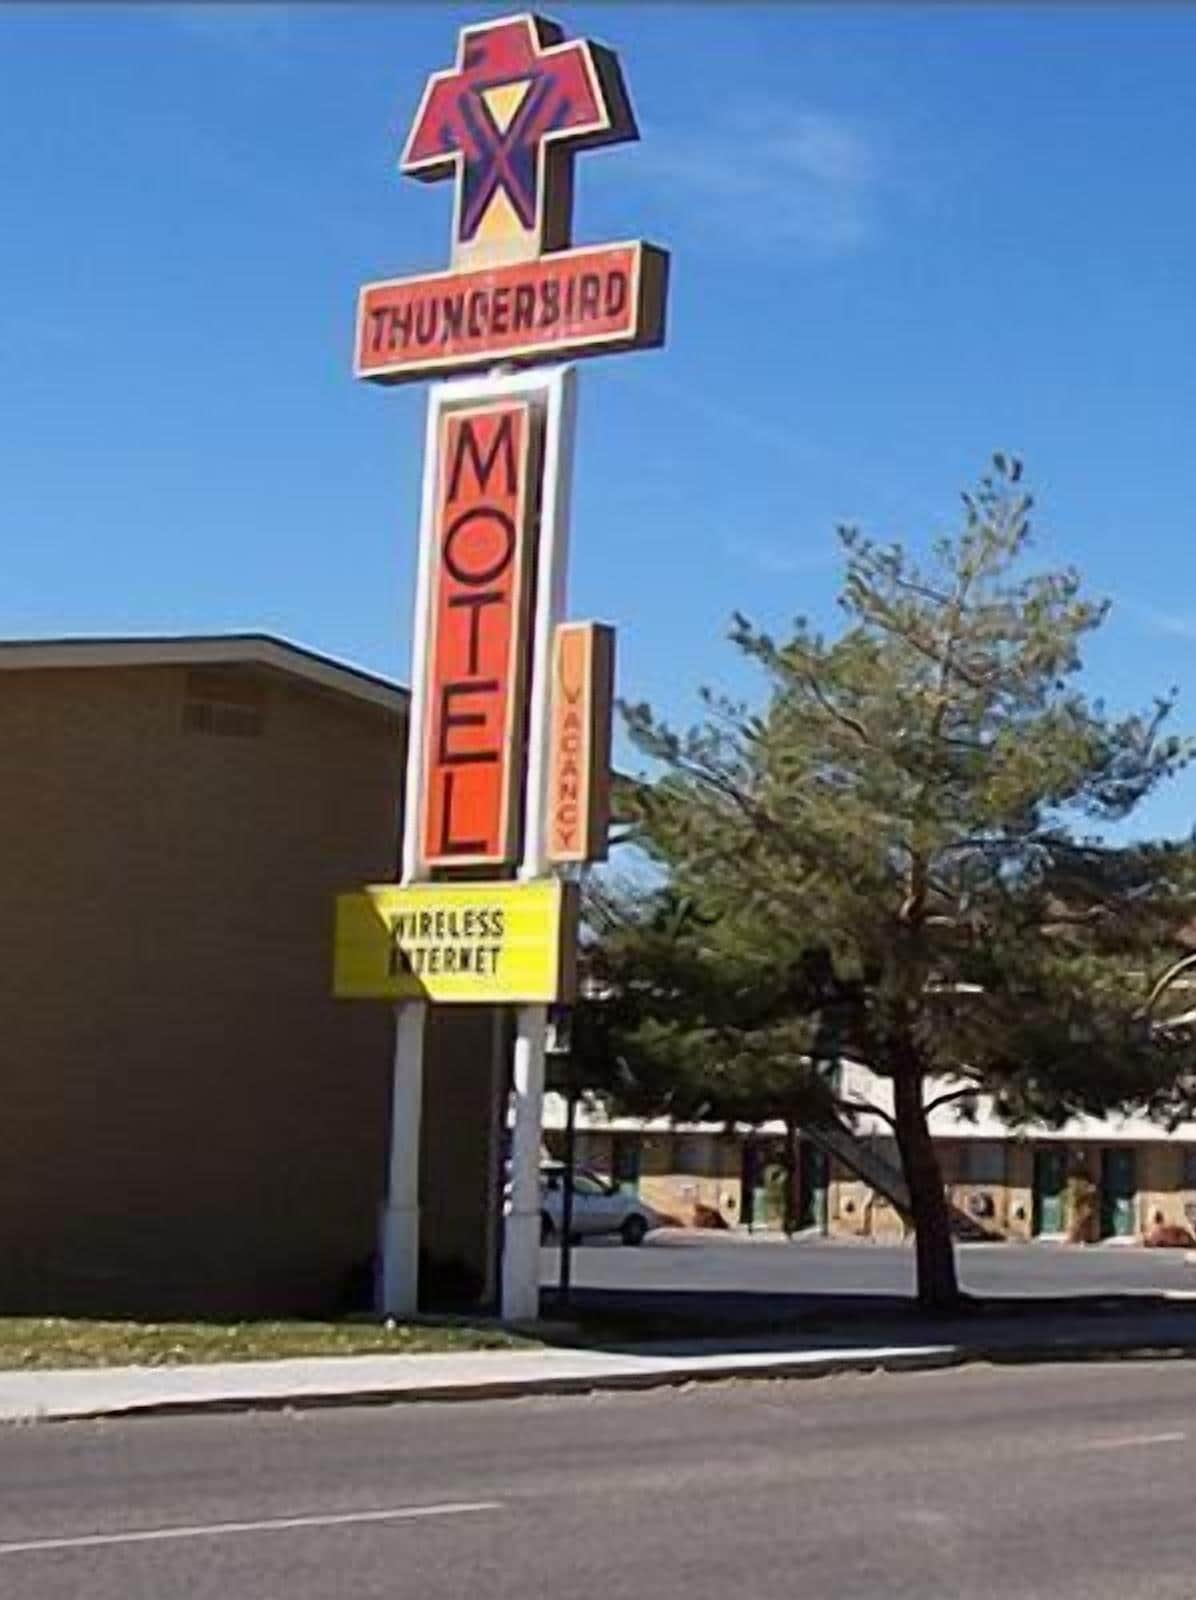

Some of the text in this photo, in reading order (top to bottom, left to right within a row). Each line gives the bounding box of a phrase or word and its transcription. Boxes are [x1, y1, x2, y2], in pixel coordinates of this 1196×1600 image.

[371, 271, 628, 351] THUNDERBIRD
[438, 419, 517, 855] MOTEL
[557, 632, 584, 848] VACANCY
[388, 945, 501, 976] INTERNET
[389, 910, 504, 939] WIRELESS
